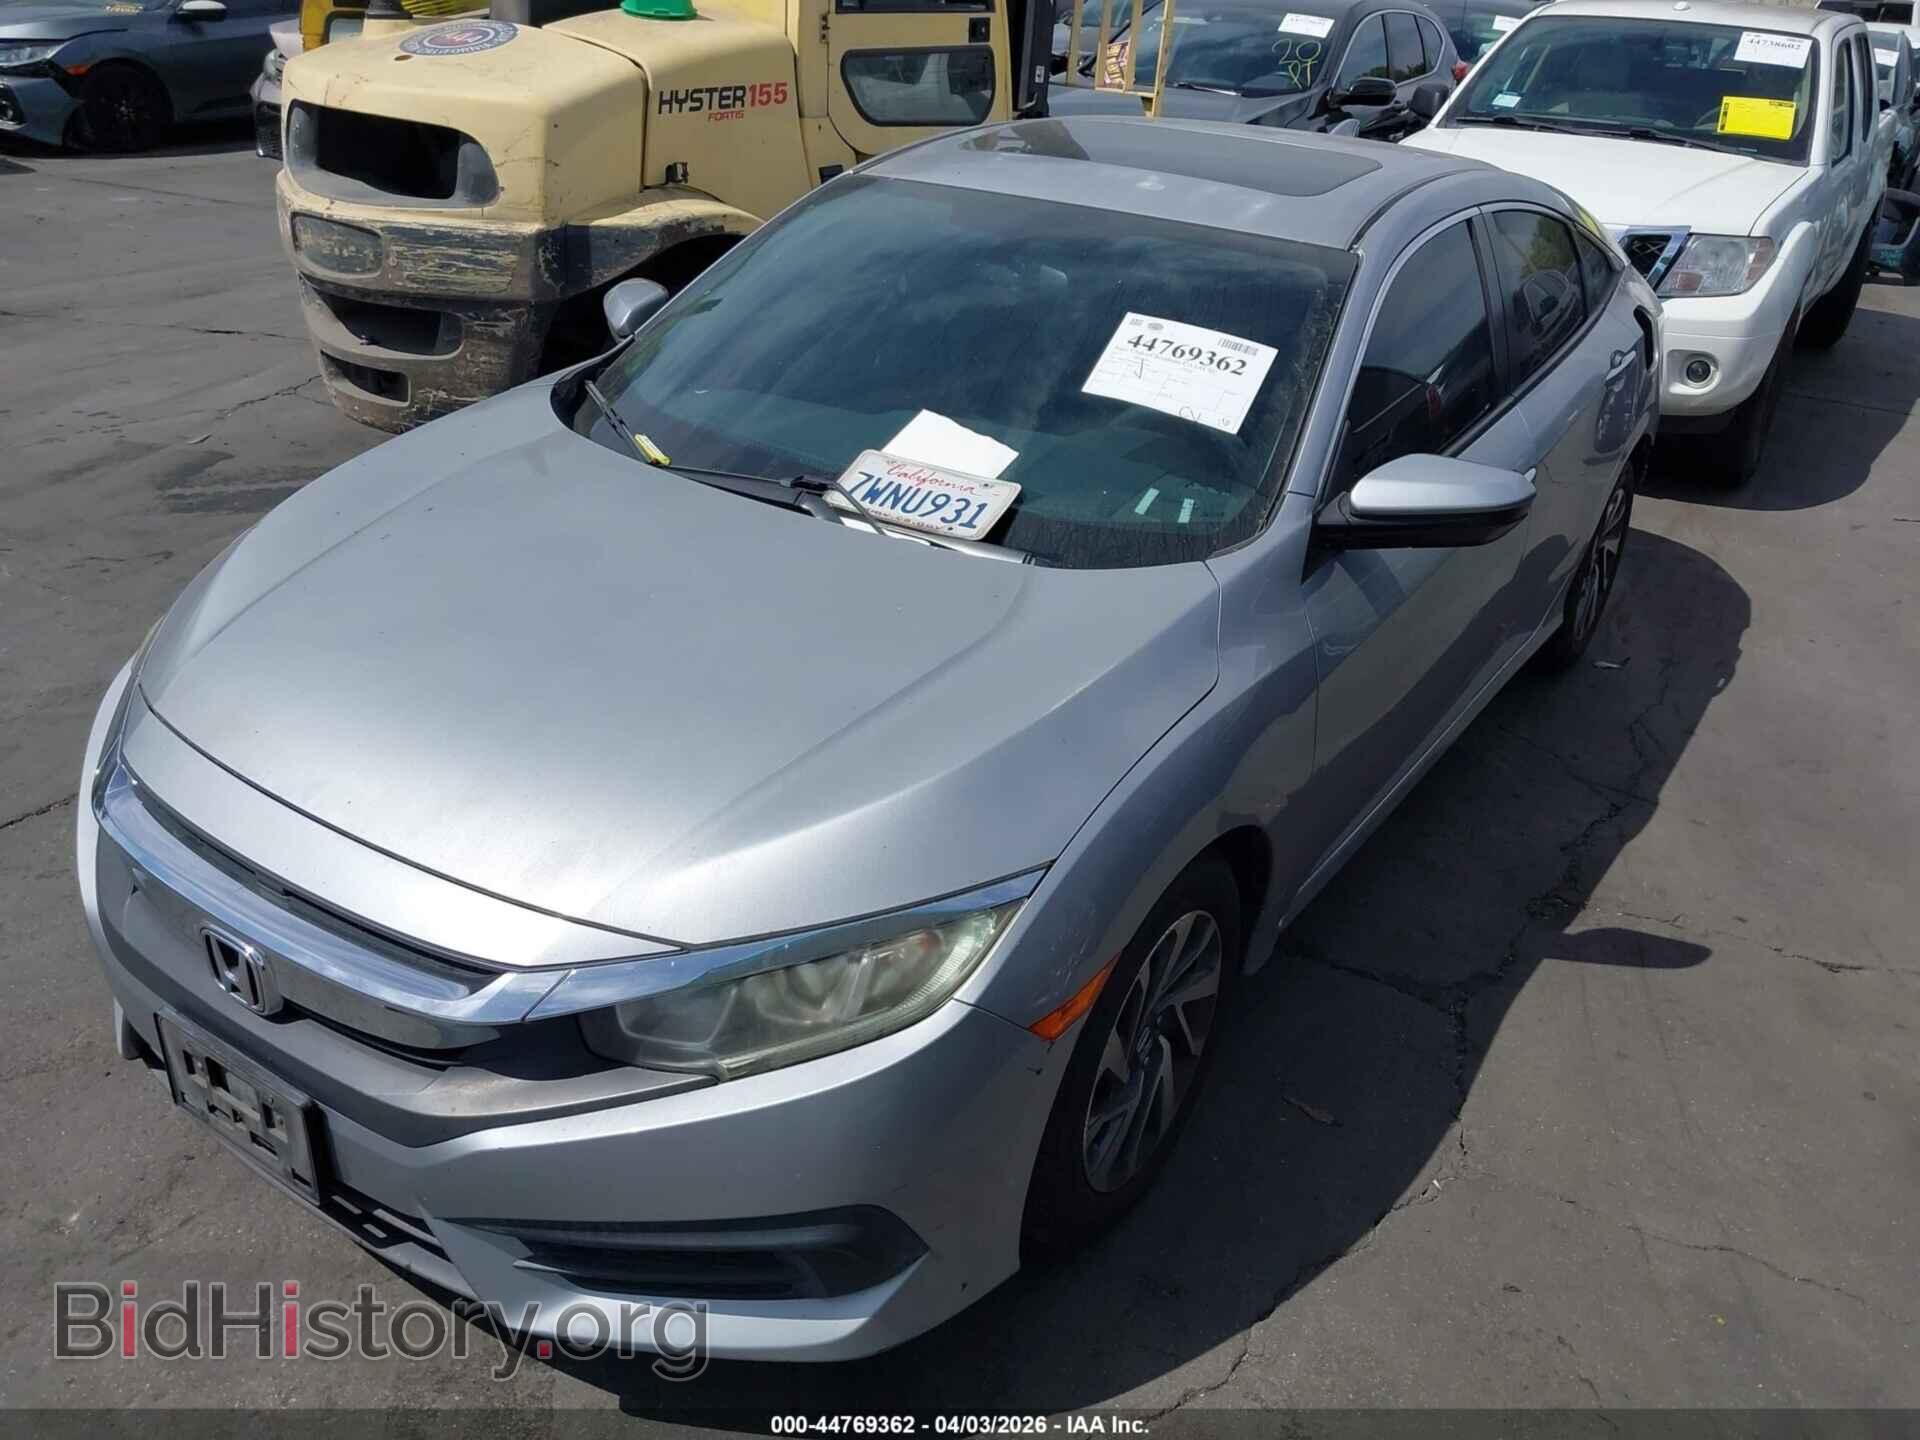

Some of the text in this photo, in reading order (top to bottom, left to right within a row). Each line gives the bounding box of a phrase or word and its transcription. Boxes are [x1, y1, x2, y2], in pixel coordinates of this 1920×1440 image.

[1271, 38, 1322, 65] 20
[1127, 334, 1248, 376] 44769362
[885, 463, 979, 496] California
[849, 471, 988, 529] 7WNU931
